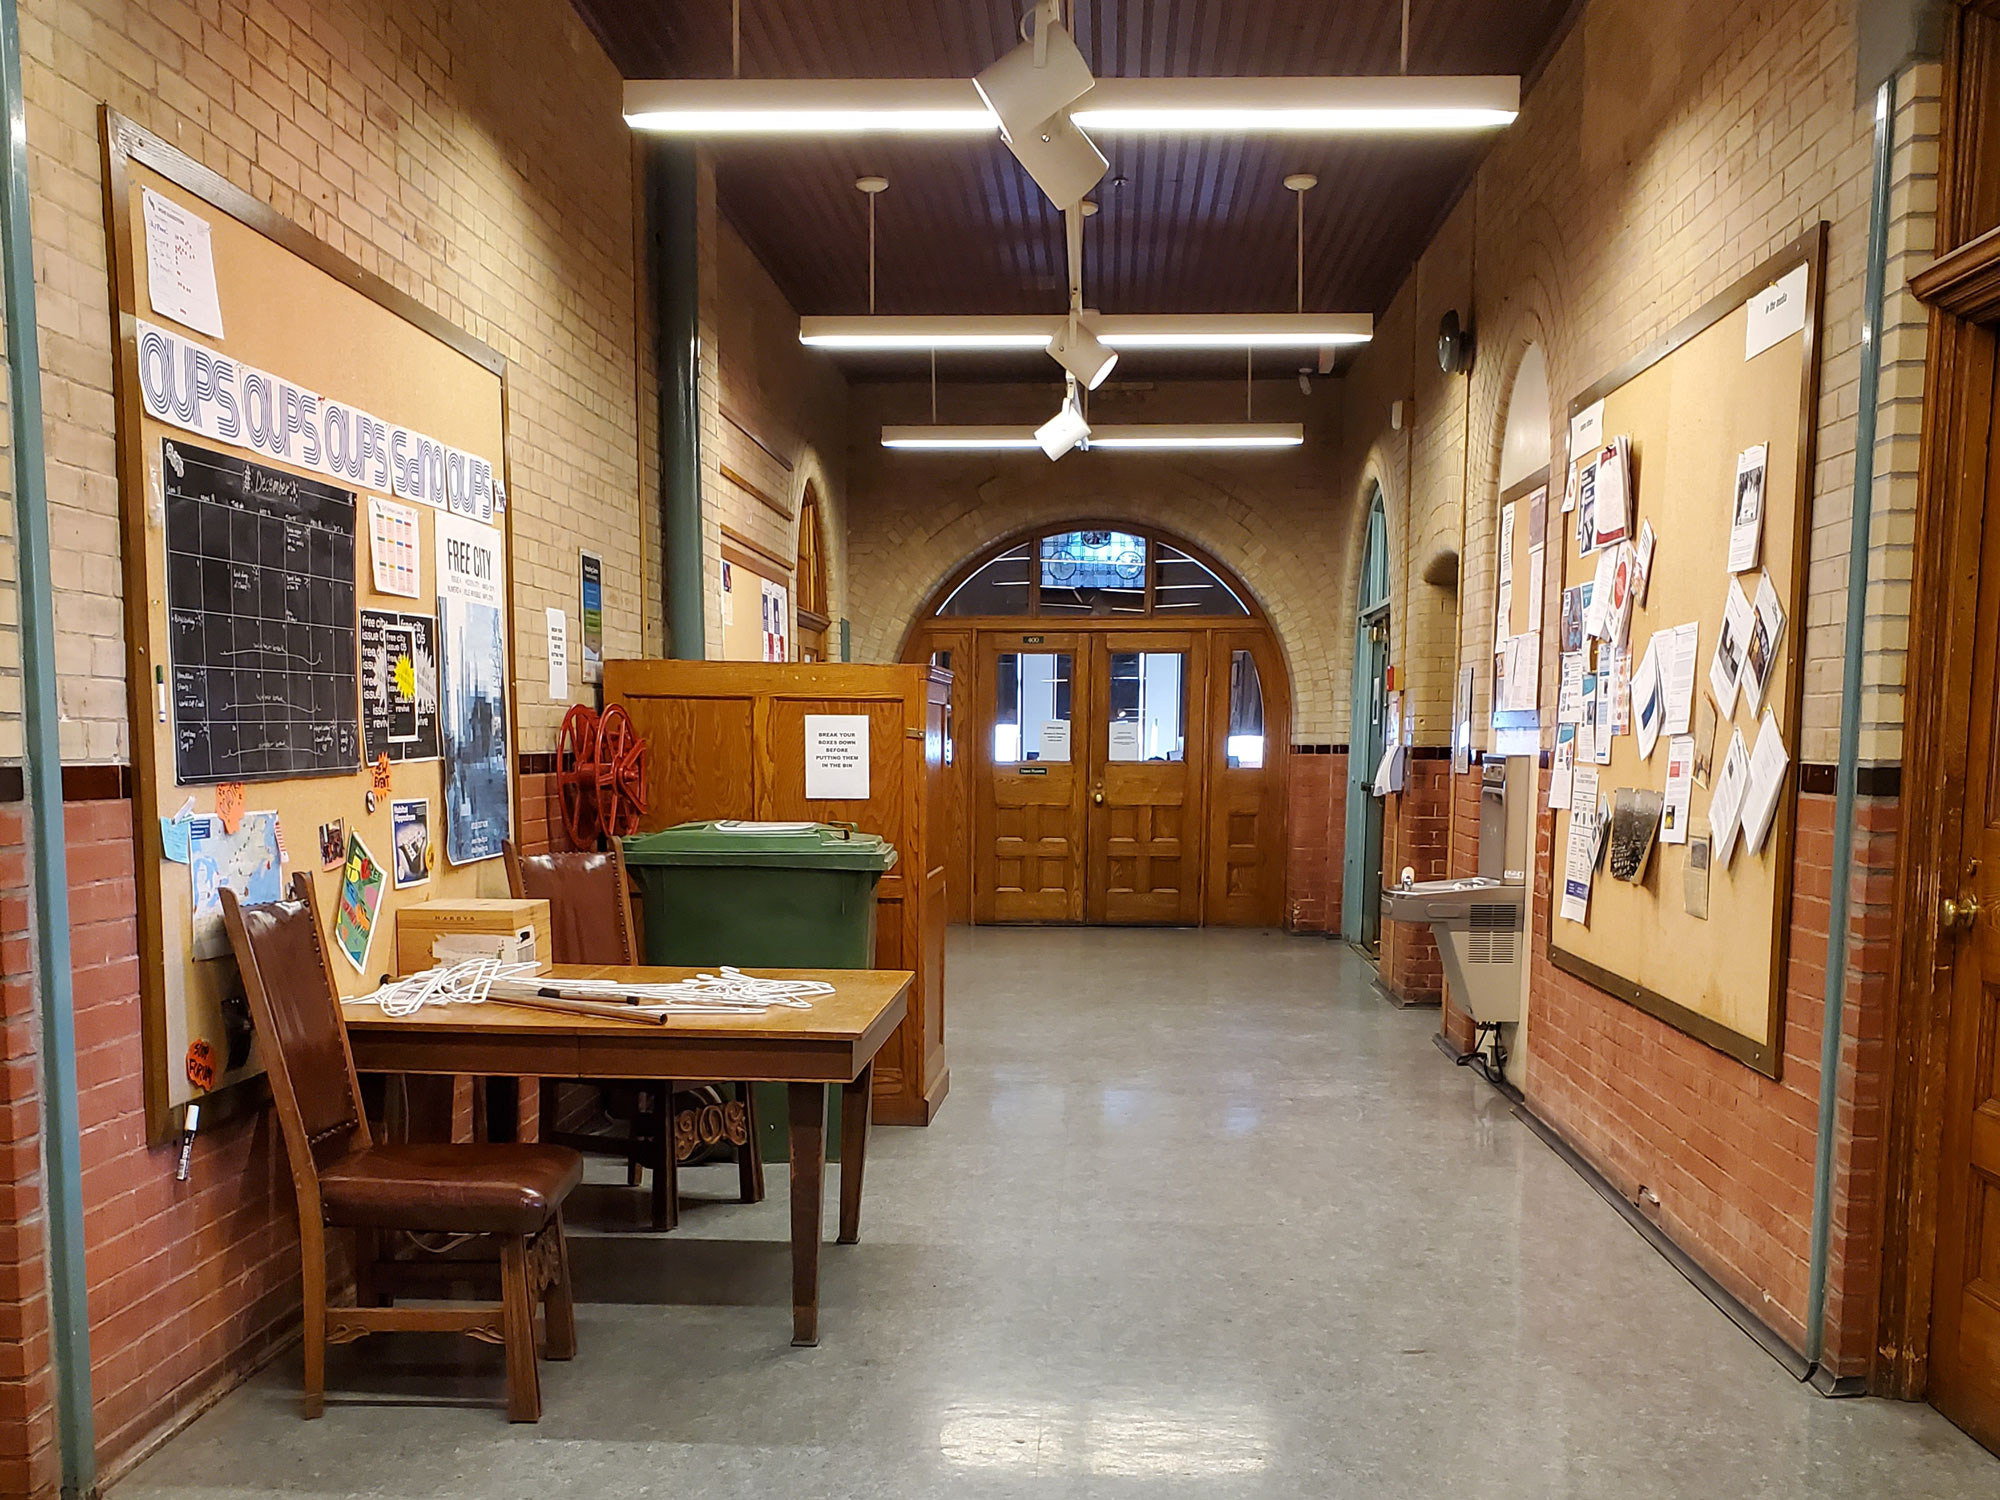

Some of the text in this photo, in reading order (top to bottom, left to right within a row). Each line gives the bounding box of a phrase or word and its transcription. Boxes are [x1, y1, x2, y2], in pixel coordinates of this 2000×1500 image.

[141, 331, 240, 438] OUPS
[243, 373, 321, 466] OUPS
[324, 405, 388, 488] OUPS
[448, 452, 492, 520] OUPS
[255, 470, 289, 497] December
[447, 537, 491, 581] FREE CITY
[361, 628, 379, 641] issue
[362, 614, 375, 628] free
